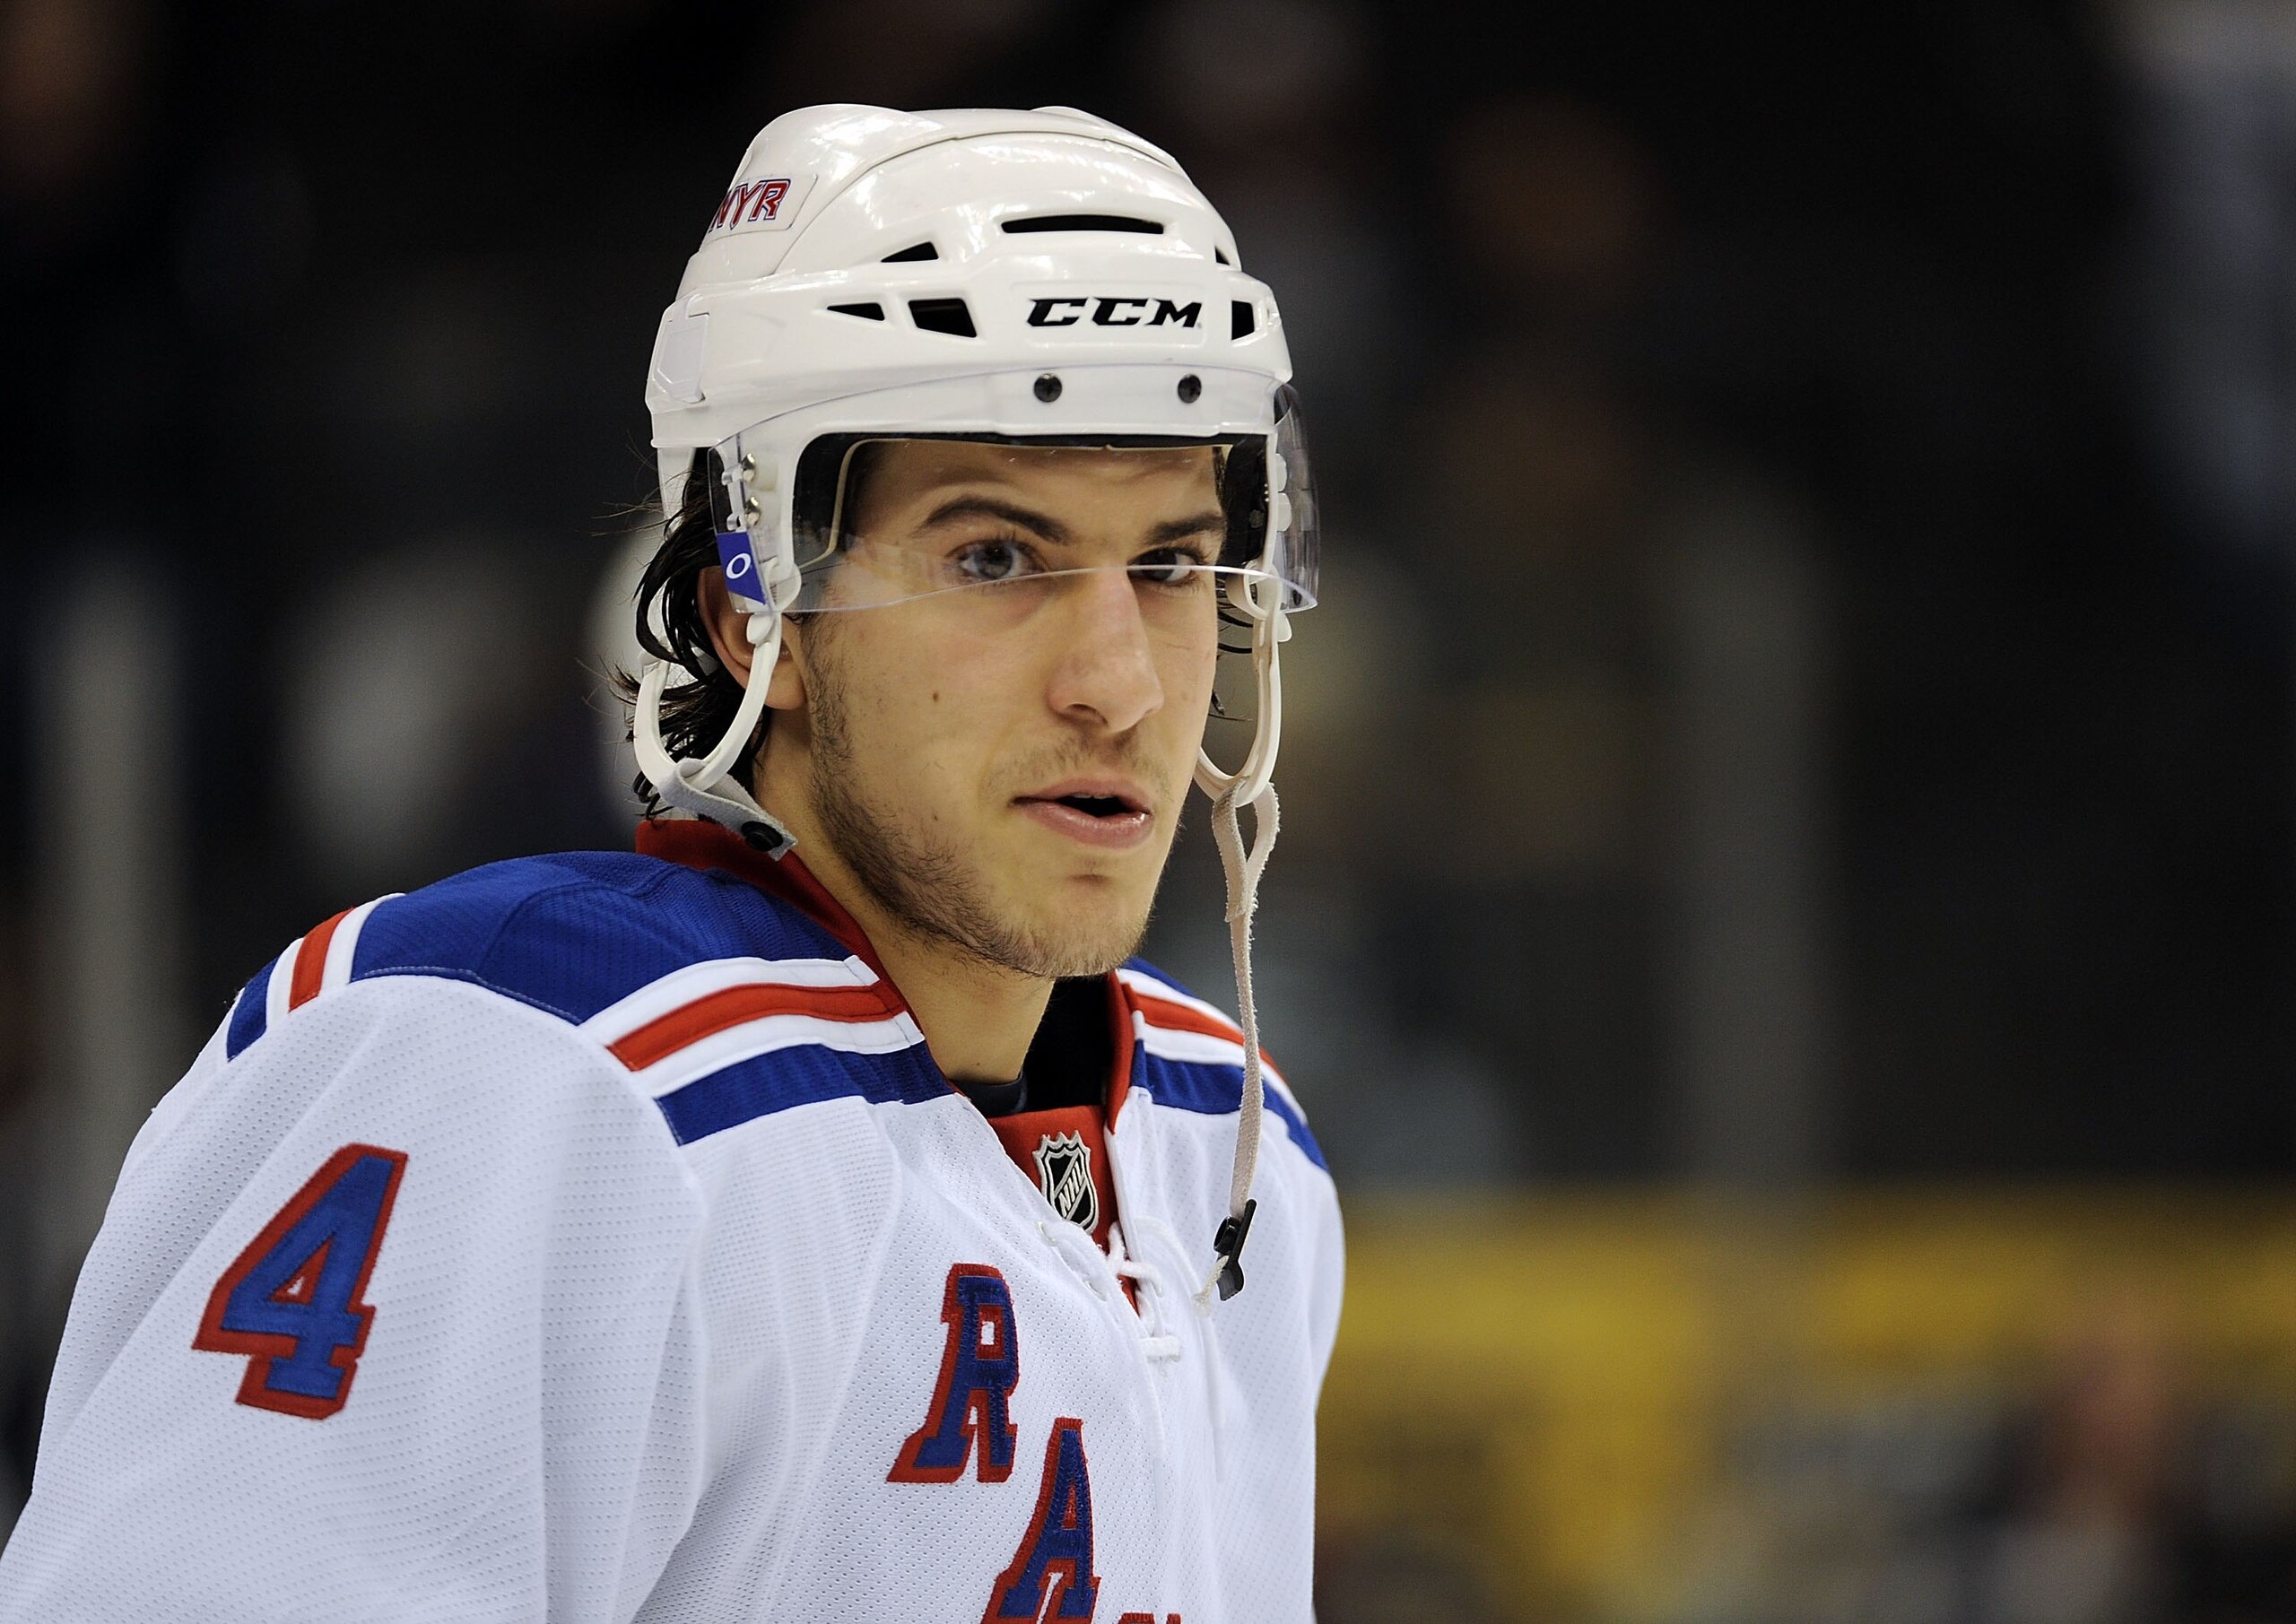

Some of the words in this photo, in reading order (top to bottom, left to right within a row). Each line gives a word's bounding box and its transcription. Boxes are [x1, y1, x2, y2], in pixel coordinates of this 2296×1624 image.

[1027, 297, 1202, 328] CCM
[1057, 1160, 1086, 1218] NHL
[190, 1142, 410, 1421] 4
[886, 1263, 1182, 1624] RA
